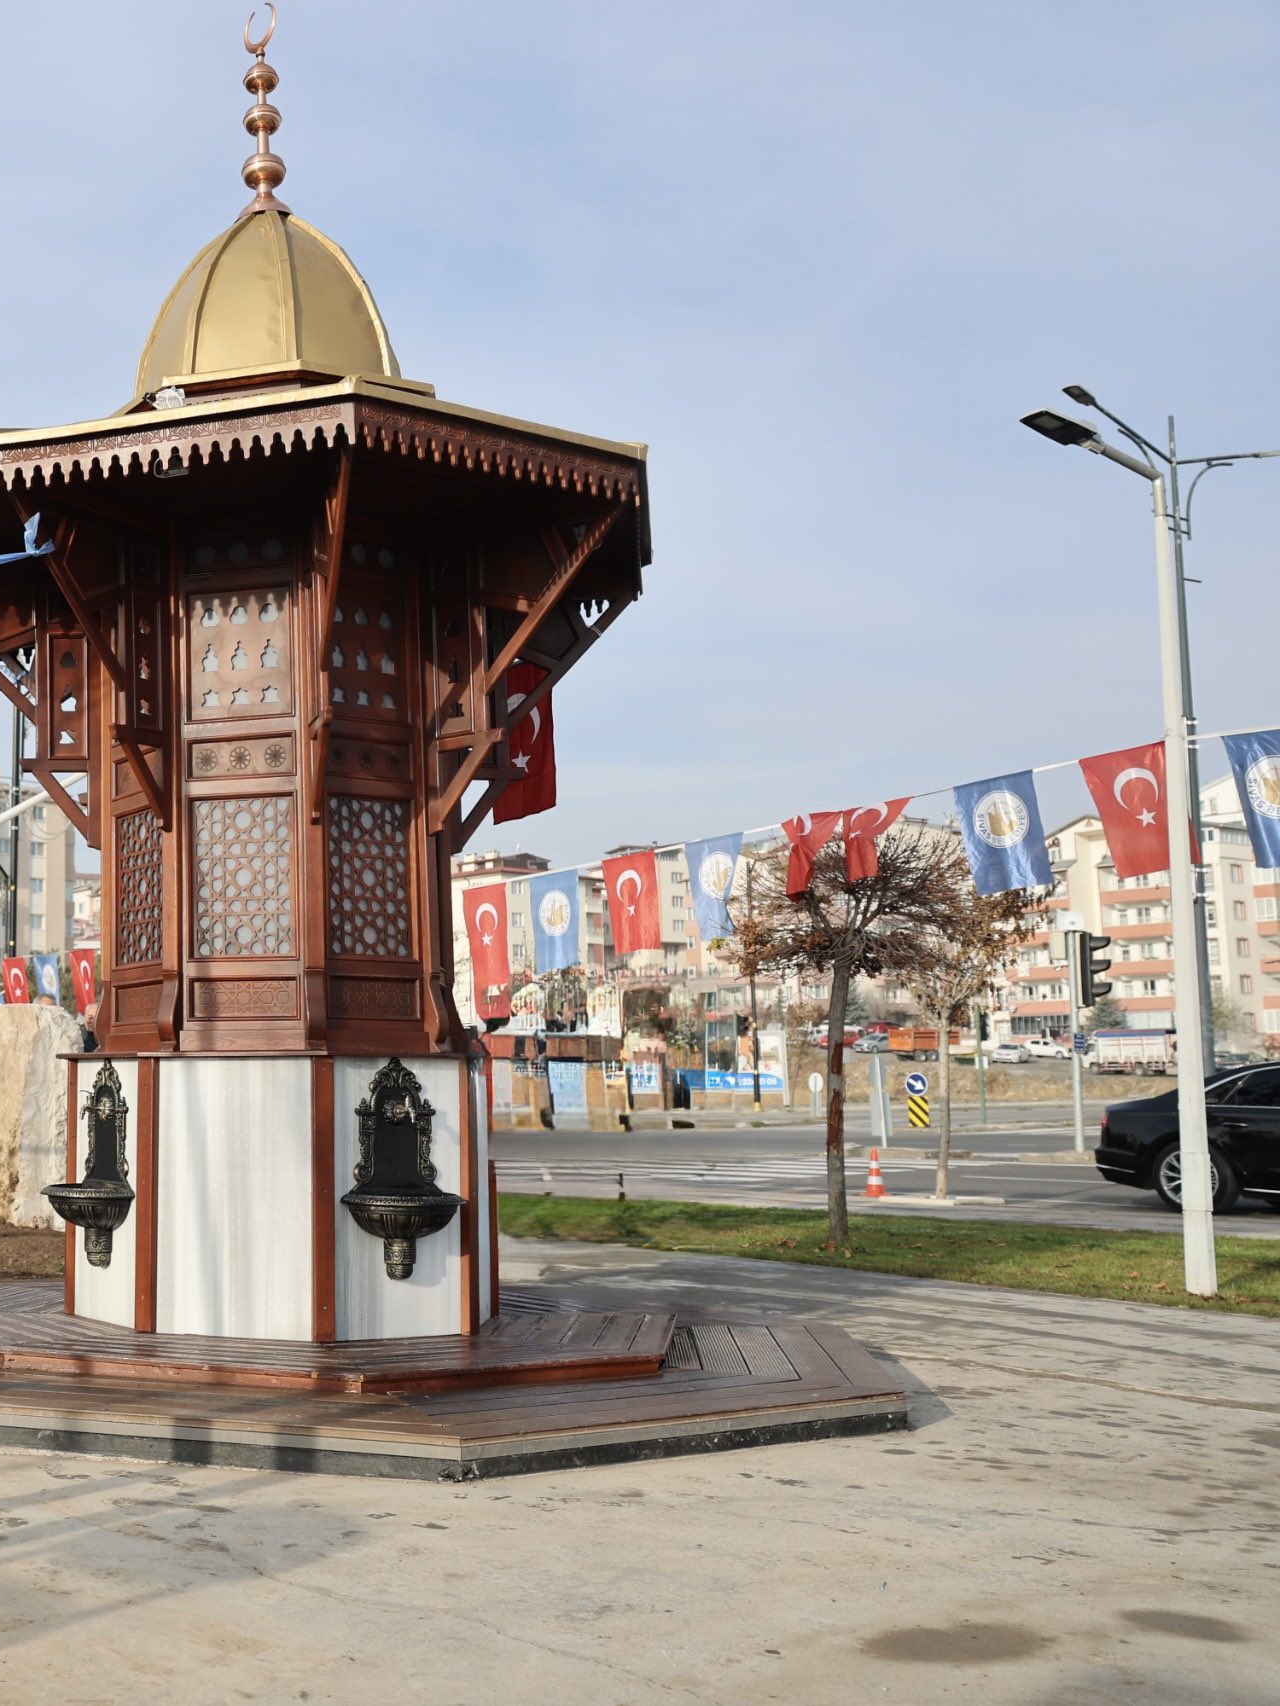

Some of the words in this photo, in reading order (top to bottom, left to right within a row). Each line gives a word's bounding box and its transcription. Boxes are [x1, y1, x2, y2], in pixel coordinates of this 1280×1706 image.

[1248, 778, 1266, 808] SIVAS
[978, 813, 991, 839] SIVAS
[992, 805, 1026, 844] BEEDİYESİ
